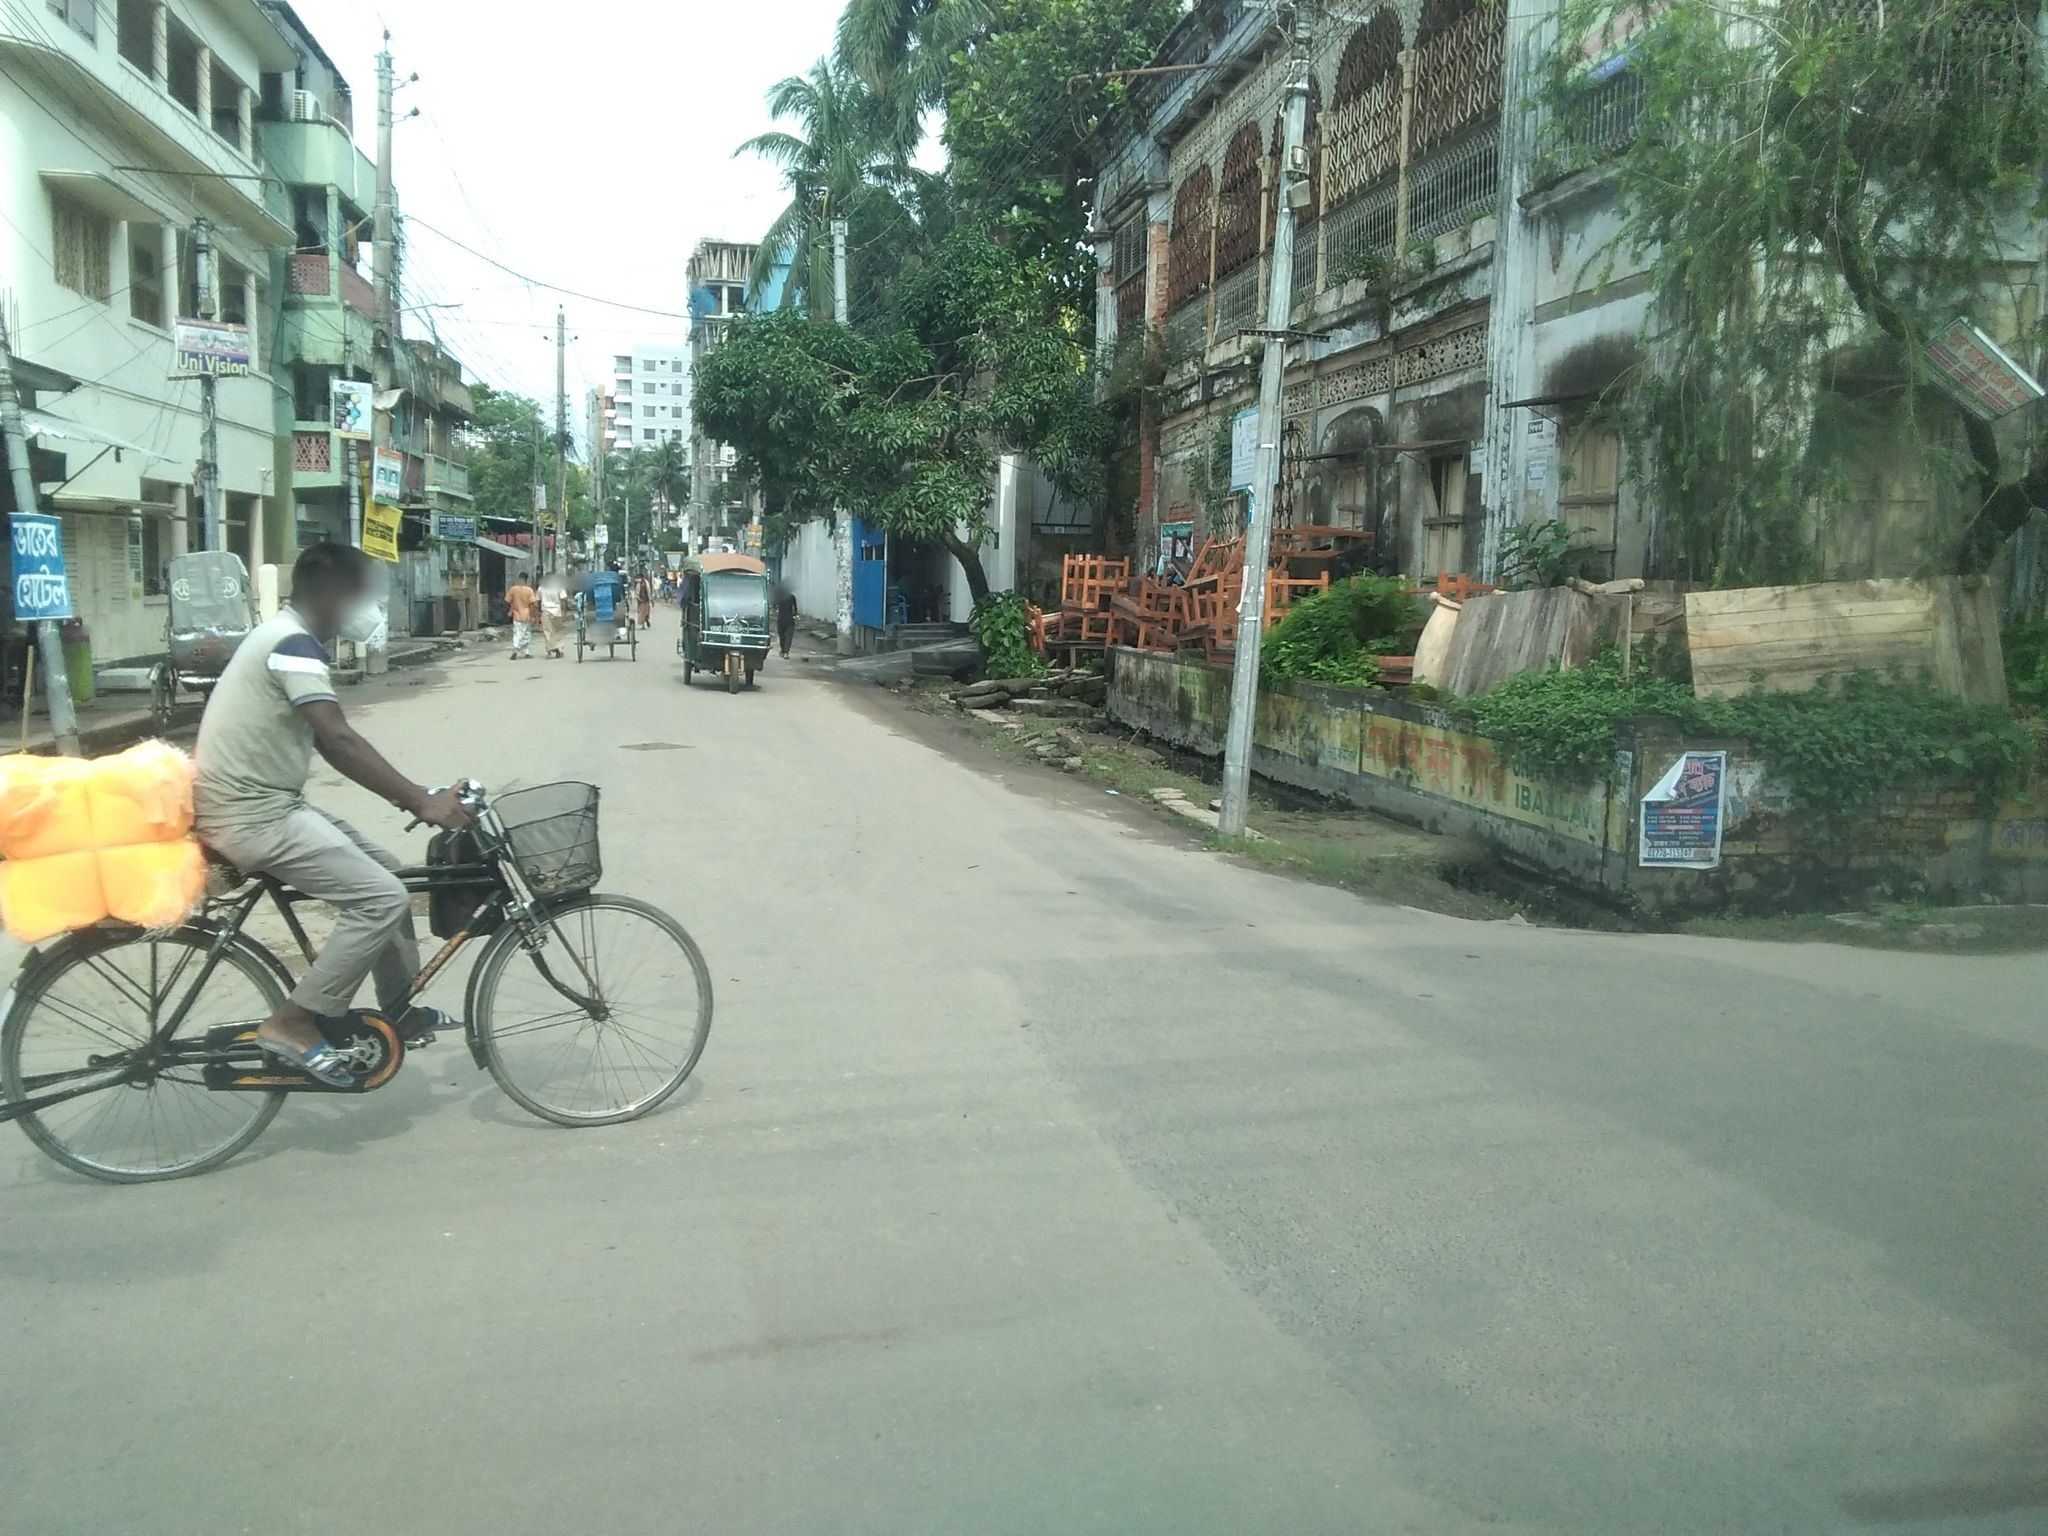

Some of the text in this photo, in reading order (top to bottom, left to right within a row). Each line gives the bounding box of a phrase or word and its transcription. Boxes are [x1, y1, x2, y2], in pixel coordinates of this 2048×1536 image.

[178, 351, 248, 376] Uni Vision
[13, 522, 58, 557] ভাতের
[17, 564, 68, 608] হোটেল
